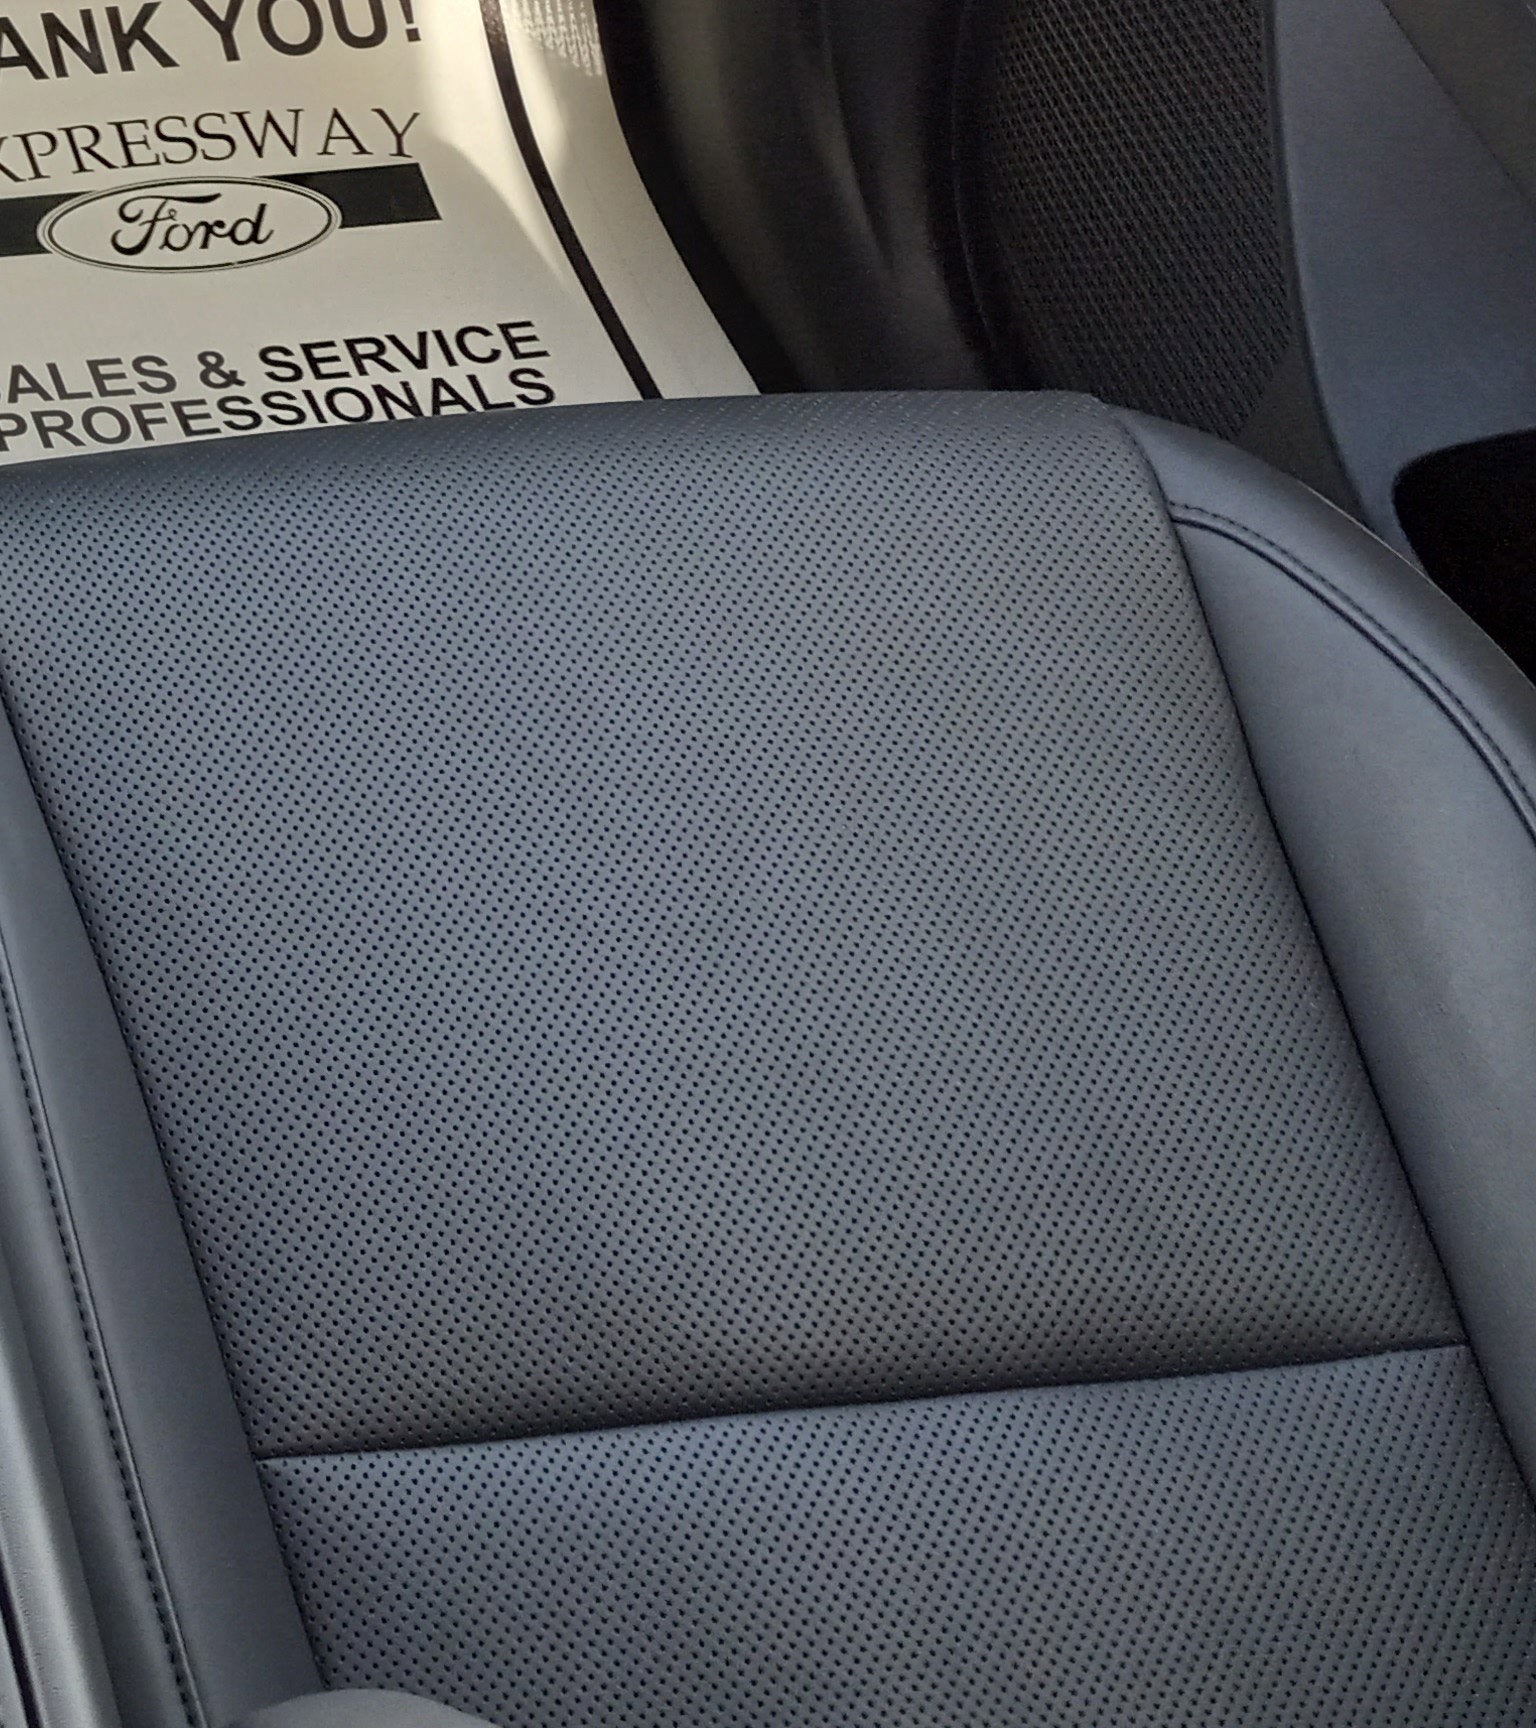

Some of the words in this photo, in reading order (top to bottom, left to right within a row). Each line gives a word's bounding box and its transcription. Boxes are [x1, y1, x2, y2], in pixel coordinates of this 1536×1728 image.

[110, 192, 274, 256] Ford
[196, 350, 246, 390] &
[258, 320, 551, 383] SERVICE
